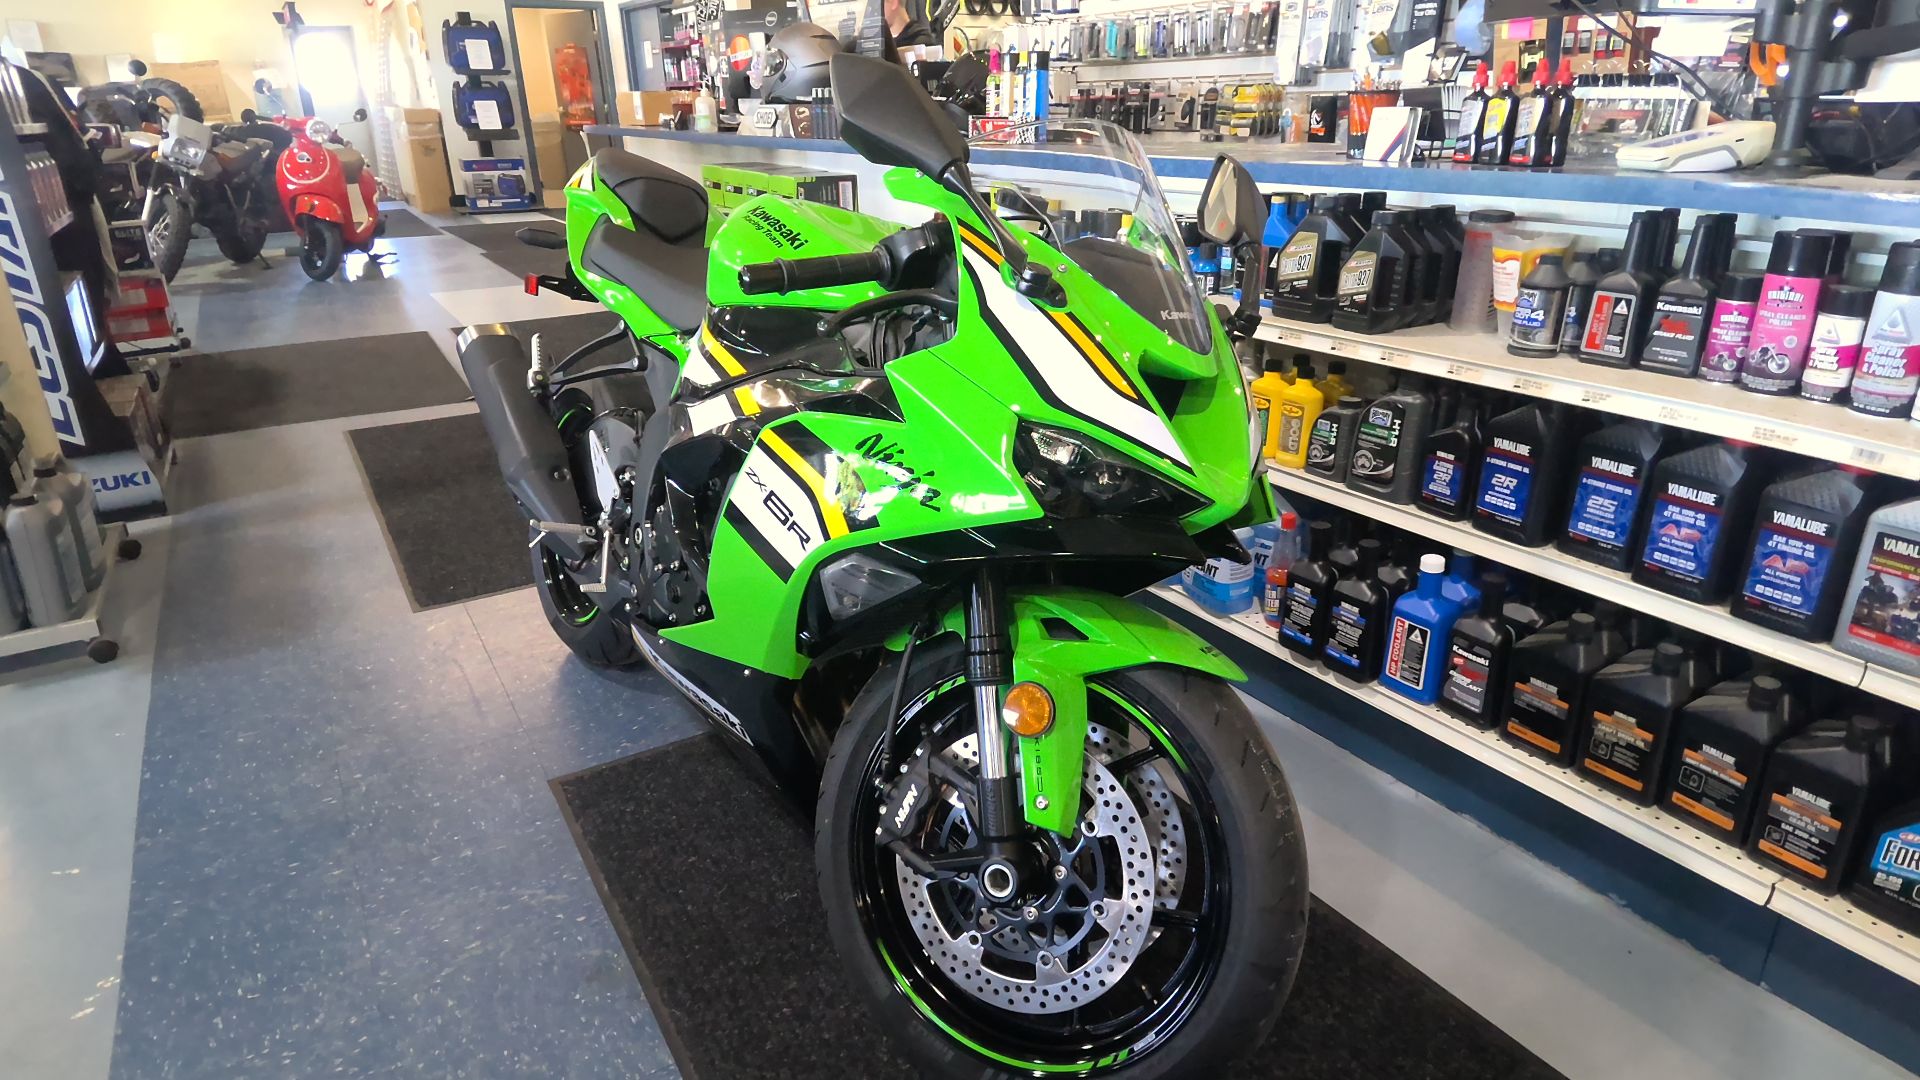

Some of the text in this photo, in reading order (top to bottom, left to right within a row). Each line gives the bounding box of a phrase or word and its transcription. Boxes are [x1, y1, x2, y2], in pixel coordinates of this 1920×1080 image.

[1307, 9, 1329, 20] Lens
[755, 110, 776, 126] SHOEI
[743, 214, 785, 249] Racing Team
[749, 205, 808, 250] Kawasaki
[1296, 253, 1313, 271] 927
[1356, 268, 1373, 287] 927
[1530, 309, 1545, 321] 4
[1656, 301, 1703, 315] Kawasaki
[1863, 350, 1908, 367] Cleaner
[1871, 343, 1907, 358] Spray
[1869, 362, 1907, 379] Polish
[1493, 437, 1532, 457] YAMALUBE
[1591, 456, 1637, 477] YAMALUBE
[1490, 473, 1518, 490] 2R
[1668, 482, 1718, 507] YAMALUBE
[744, 466, 812, 553] ZX-6R
[1773, 510, 1829, 537] YAMALUBE
[1389, 620, 1404, 675] HP COOLANT
[1452, 644, 1490, 667] Kawasaki
